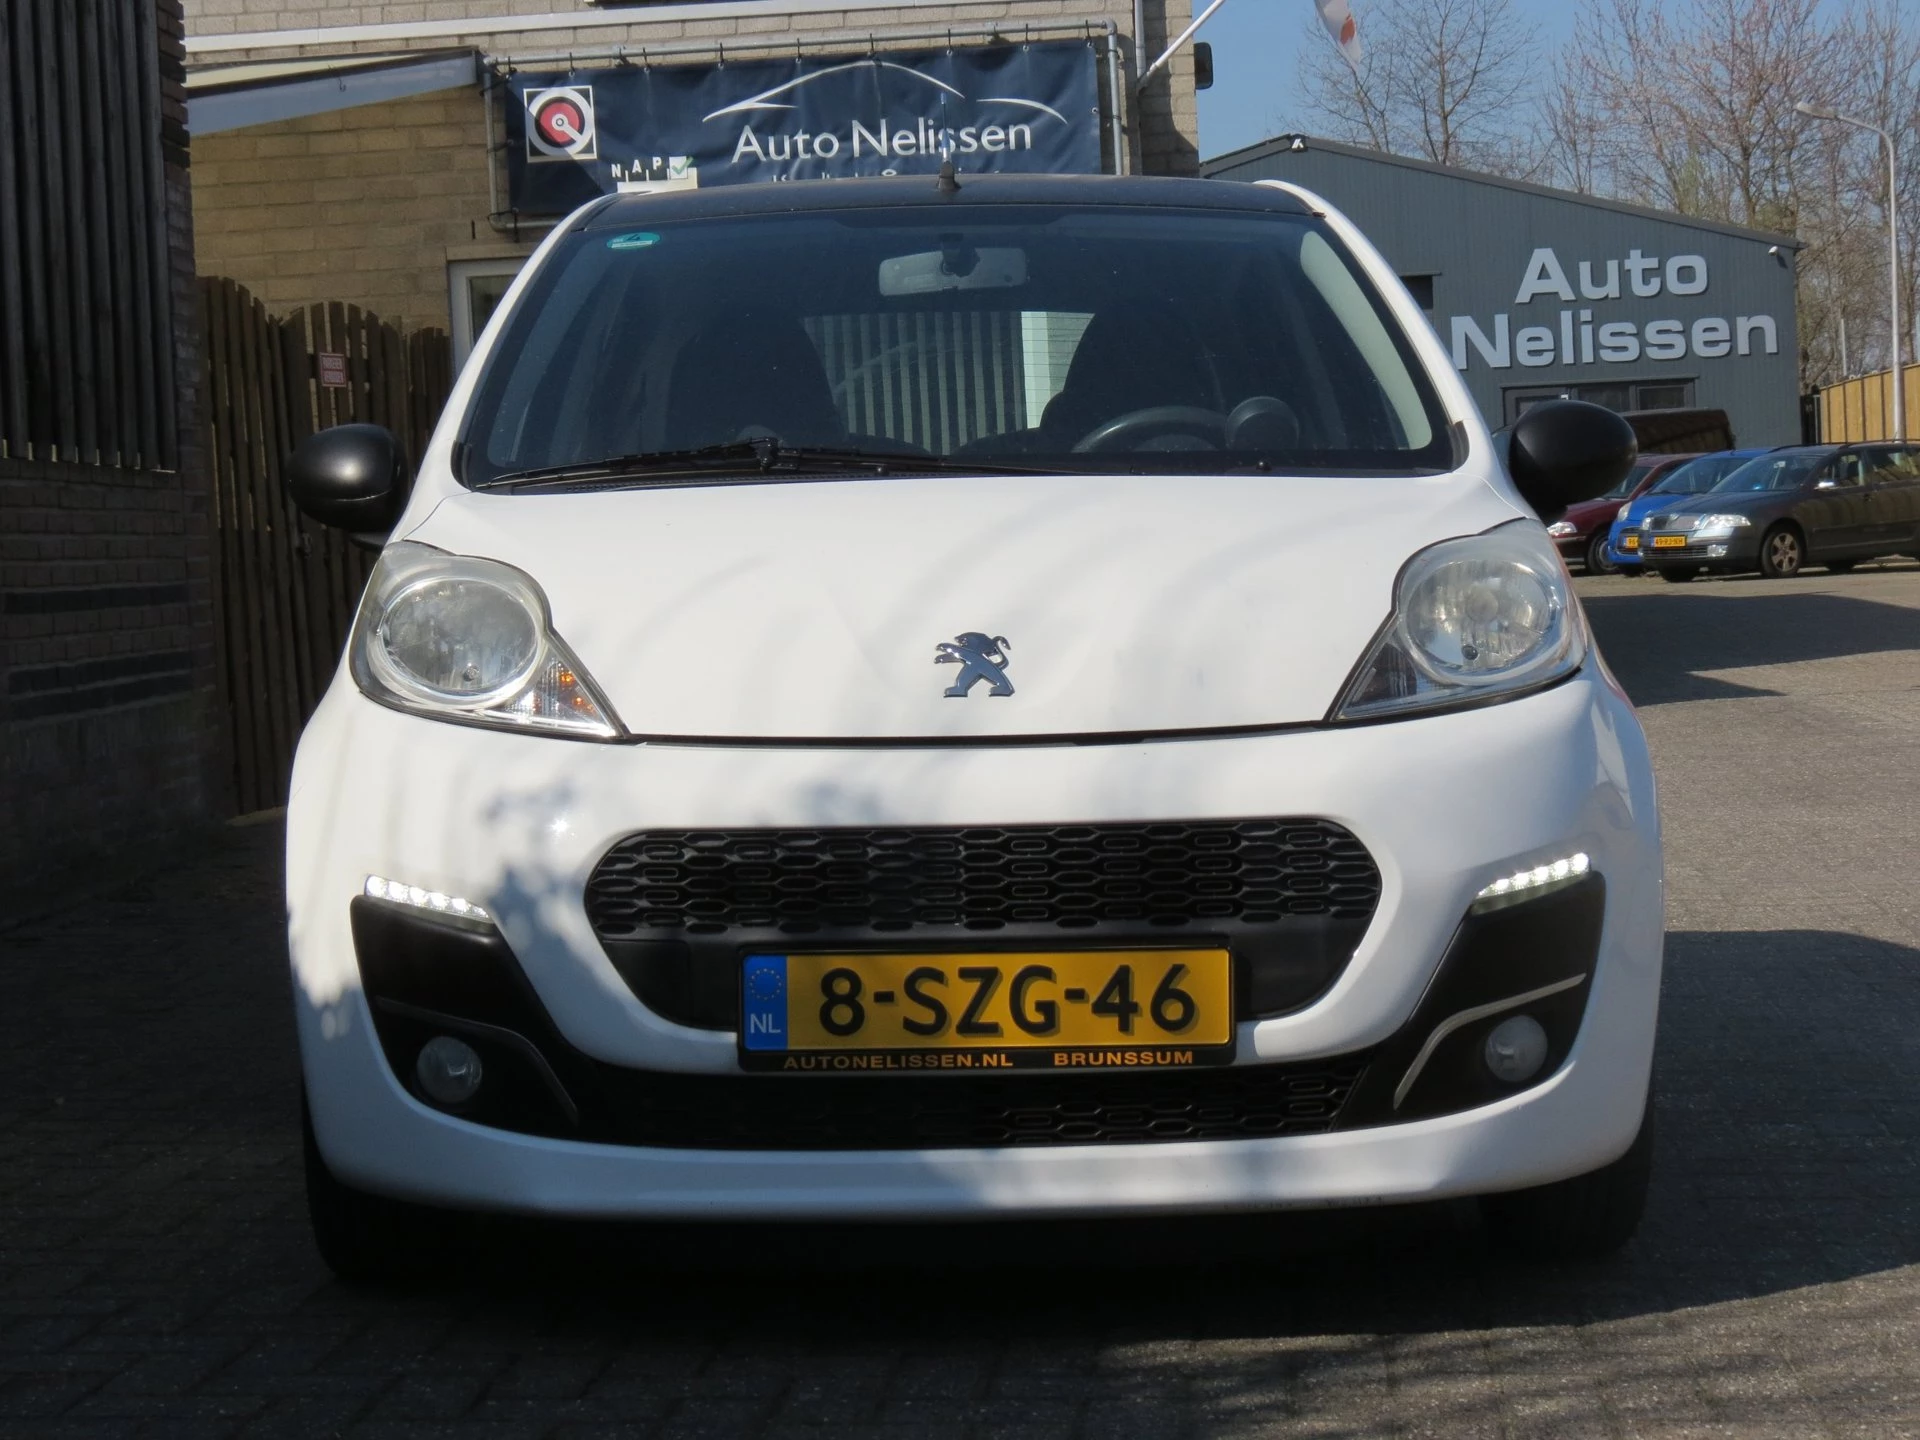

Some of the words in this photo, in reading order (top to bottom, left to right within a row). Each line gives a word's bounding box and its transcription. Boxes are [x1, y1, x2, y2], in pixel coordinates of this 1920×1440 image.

[732, 125, 839, 163] Auto
[852, 117, 1031, 158] Nelissen
[1515, 248, 1708, 304] Auto
[1451, 309, 1778, 371] Nelissen
[750, 1013, 781, 1034] NL
[819, 964, 1197, 1036] 8-SZG-46
[784, 1051, 1013, 1069] AUTONELISSEN.NL
[1054, 1050, 1193, 1066] BRUNSSUM
